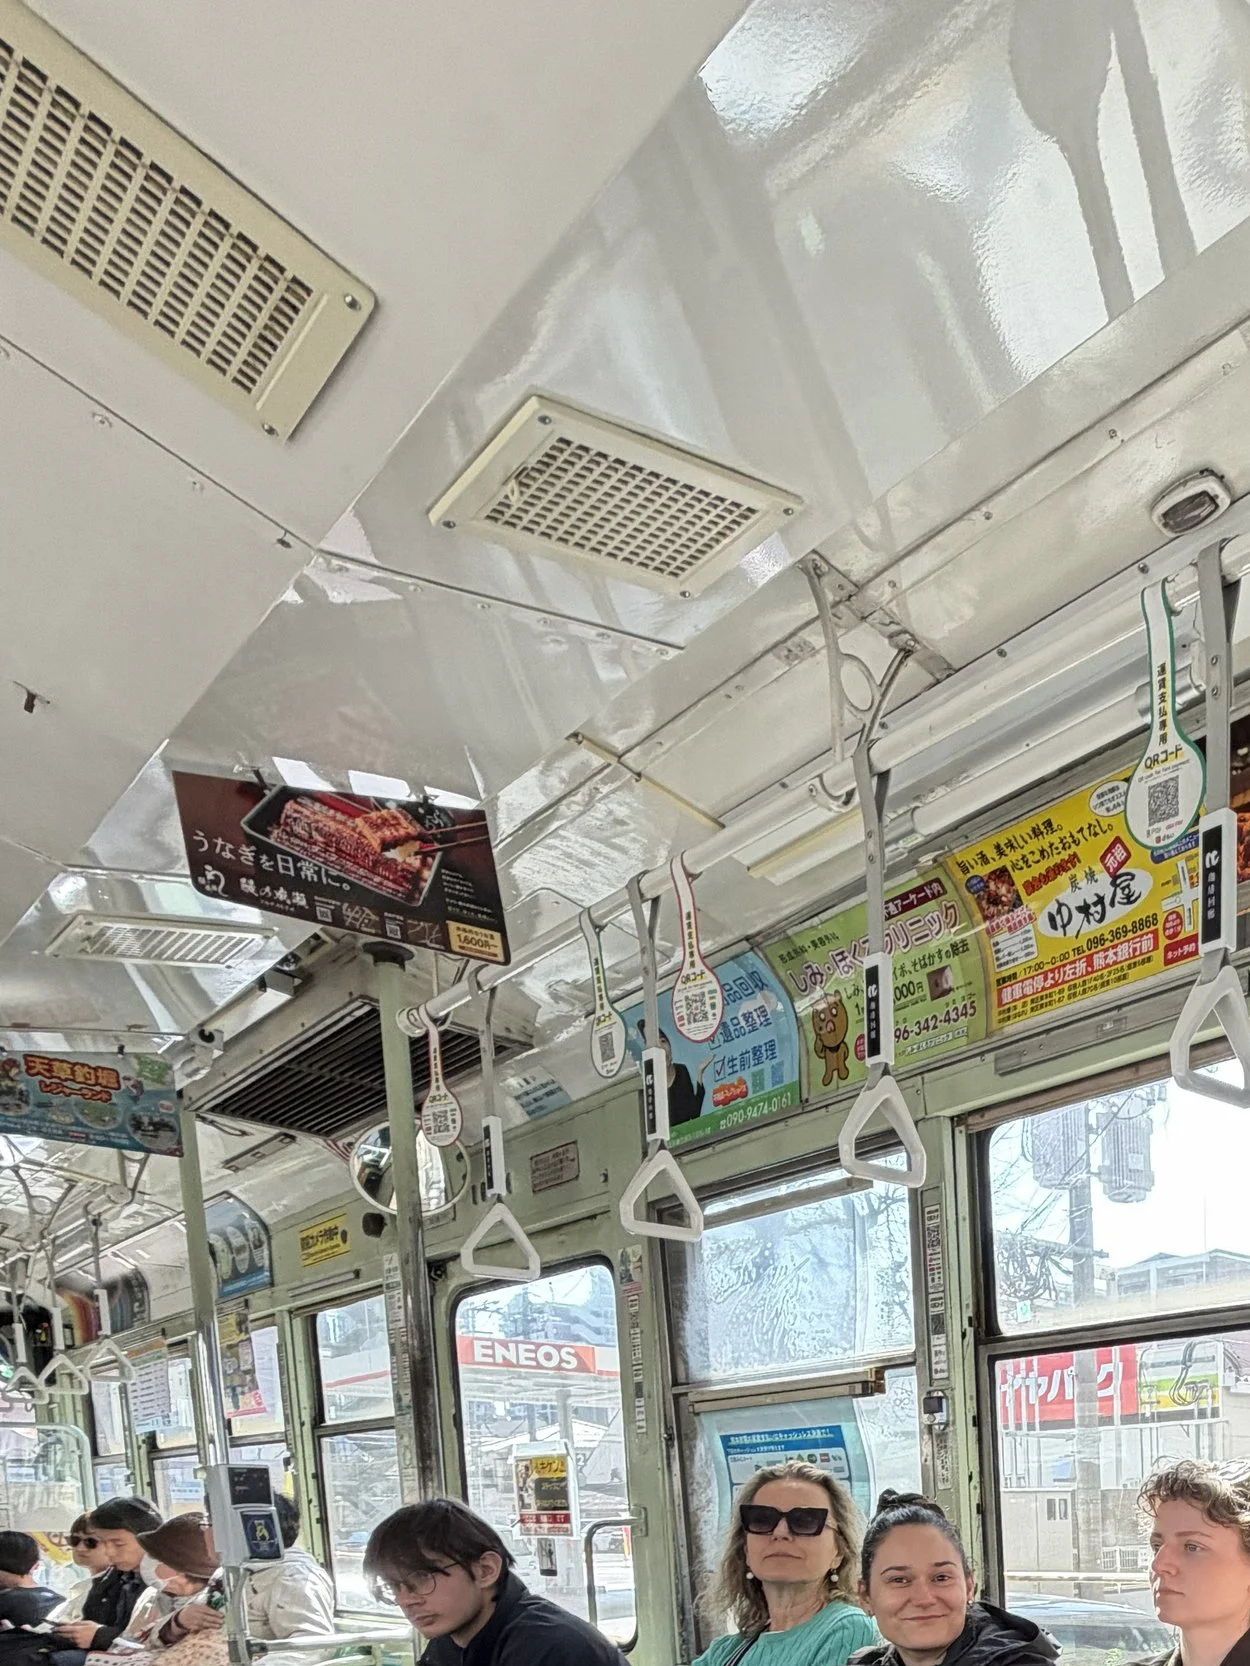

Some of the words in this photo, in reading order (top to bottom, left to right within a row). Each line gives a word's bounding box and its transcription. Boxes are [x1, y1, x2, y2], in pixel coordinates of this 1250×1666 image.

[1145, 743, 1183, 770] QRコード
[193, 830, 351, 891] うなぎを日常に。
[1010, 818, 1114, 873] 心をこめたおもてなし。
[1105, 842, 1127, 873] 元祖
[1072, 944, 1087, 957] TEL
[1087, 913, 1159, 951] 096-369-8868
[720, 1004, 773, 1044] 遺品整理
[894, 1000, 977, 1043] 96-342-4345
[728, 1039, 778, 1077] 生前整理
[727, 1092, 791, 1128] 090-9474-0161
[474, 1340, 578, 1369] ENEOS
